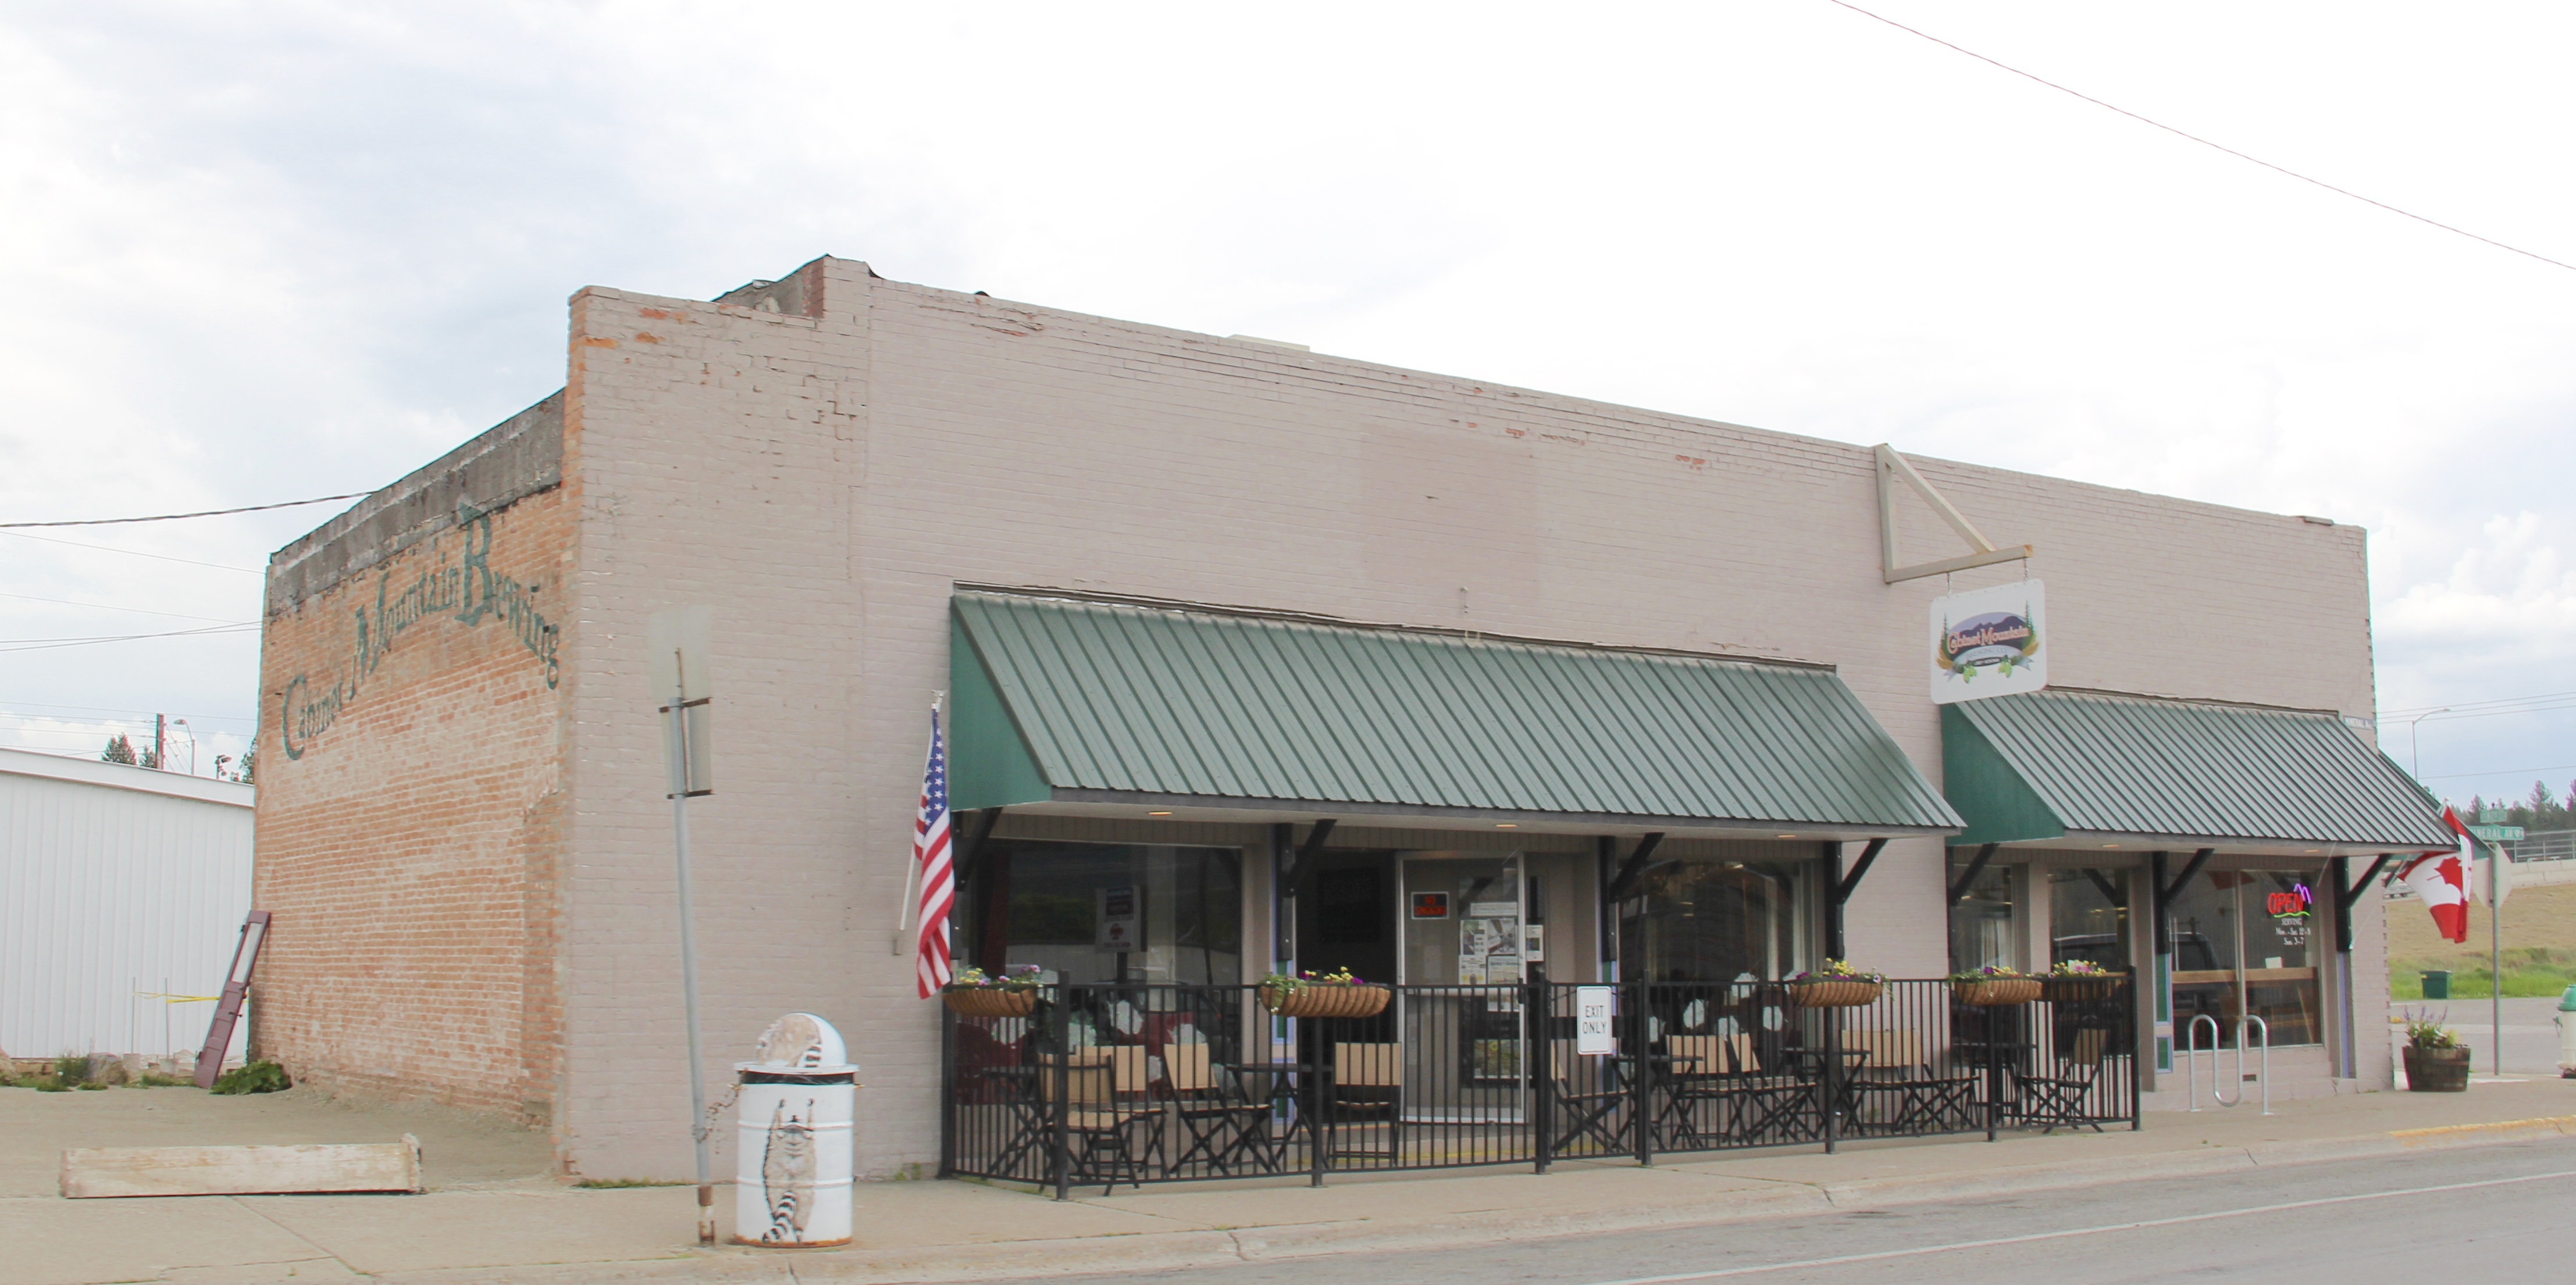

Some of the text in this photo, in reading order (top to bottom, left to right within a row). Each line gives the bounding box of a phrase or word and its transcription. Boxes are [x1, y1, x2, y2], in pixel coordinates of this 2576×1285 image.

[283, 502, 559, 761] Cabinet Mountain Brewing
[1947, 624, 2030, 654] Cabinet Mountain
[2268, 893, 2304, 914] OPEN
[1585, 1005, 1604, 1018] EXIT
[1582, 1022, 1606, 1034] ONLY
